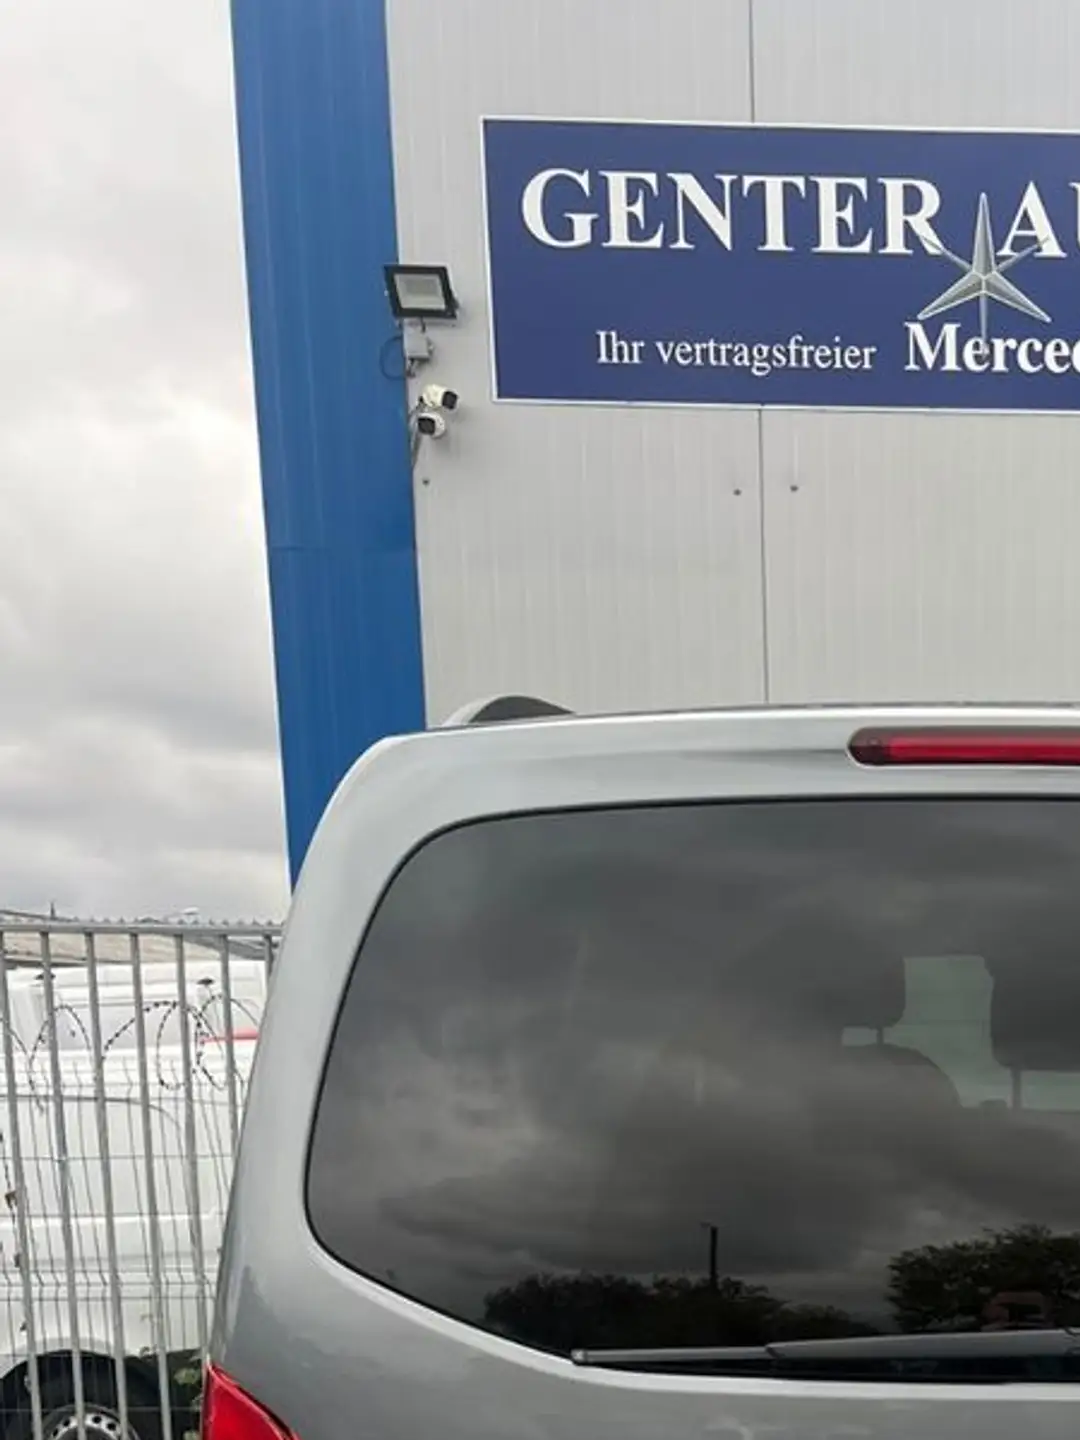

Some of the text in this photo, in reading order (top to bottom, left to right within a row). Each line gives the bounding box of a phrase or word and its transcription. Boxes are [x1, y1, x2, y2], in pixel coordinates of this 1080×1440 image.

[521, 167, 944, 257] GENTER
[596, 330, 645, 365] Ihr
[655, 334, 877, 376] vertragsfreier
